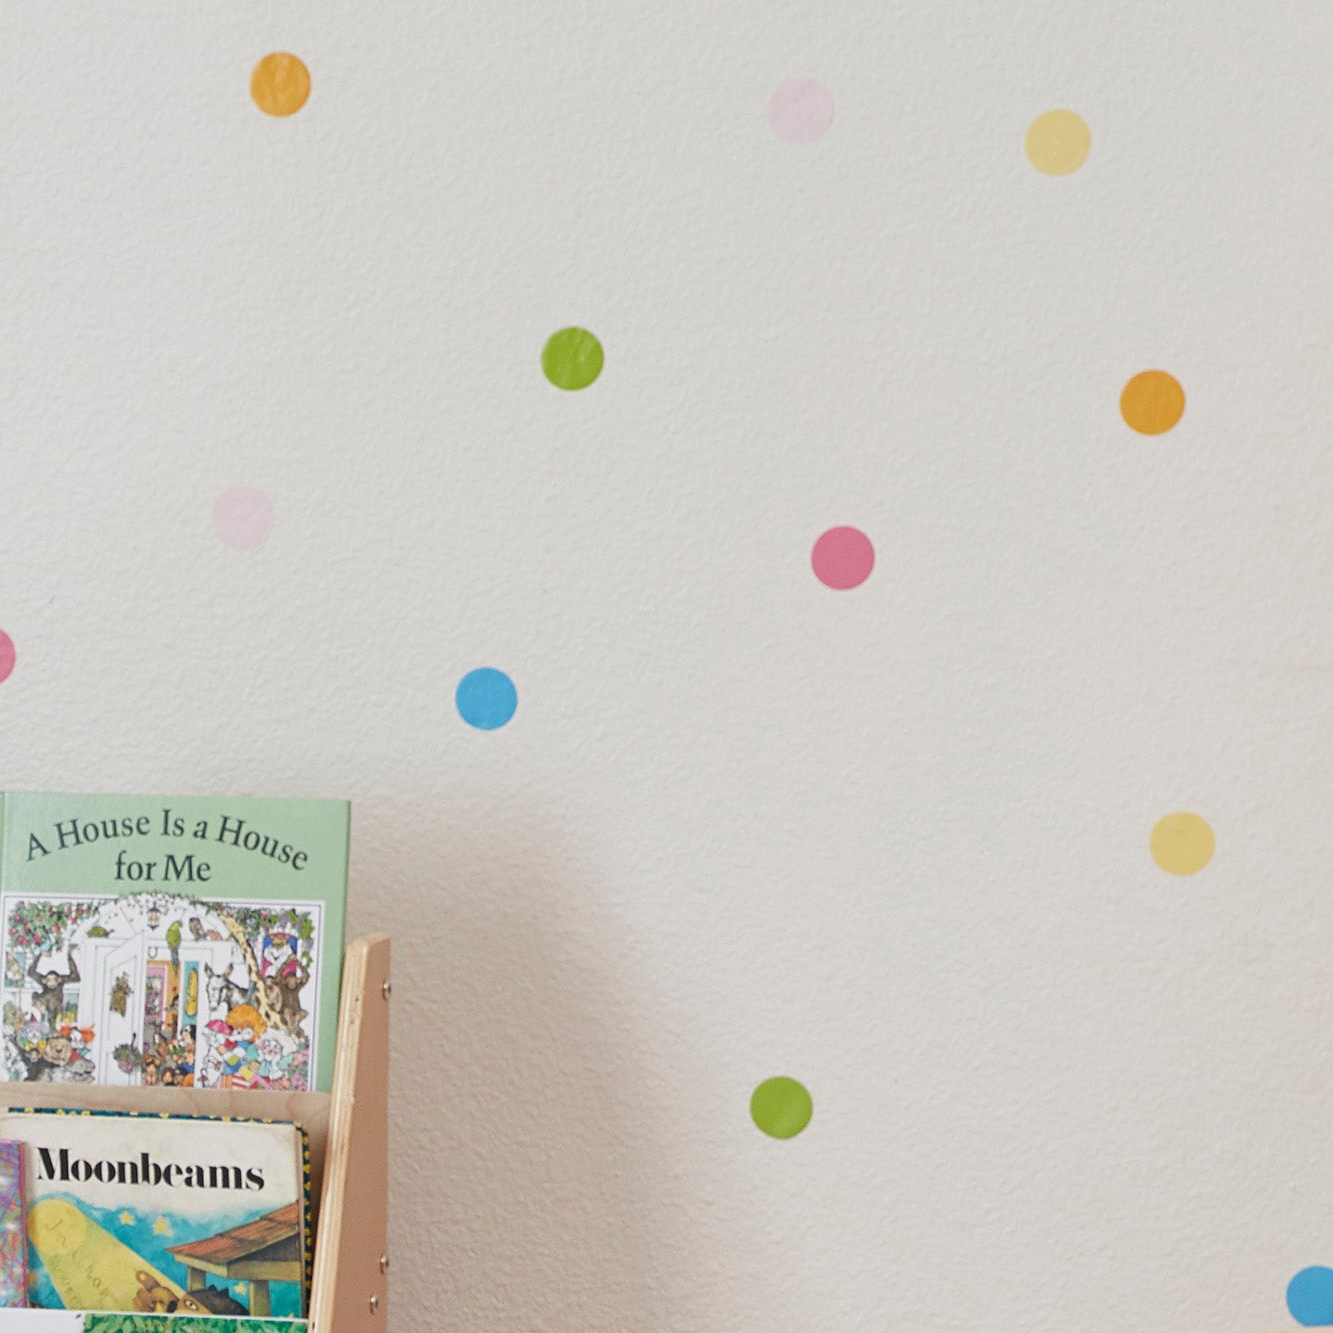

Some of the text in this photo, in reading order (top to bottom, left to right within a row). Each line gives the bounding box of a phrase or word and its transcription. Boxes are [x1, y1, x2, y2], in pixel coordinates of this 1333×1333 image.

[25, 808, 309, 872] A House Is a House
[114, 849, 212, 882] for Me
[36, 1147, 266, 1192] Moonbeams
